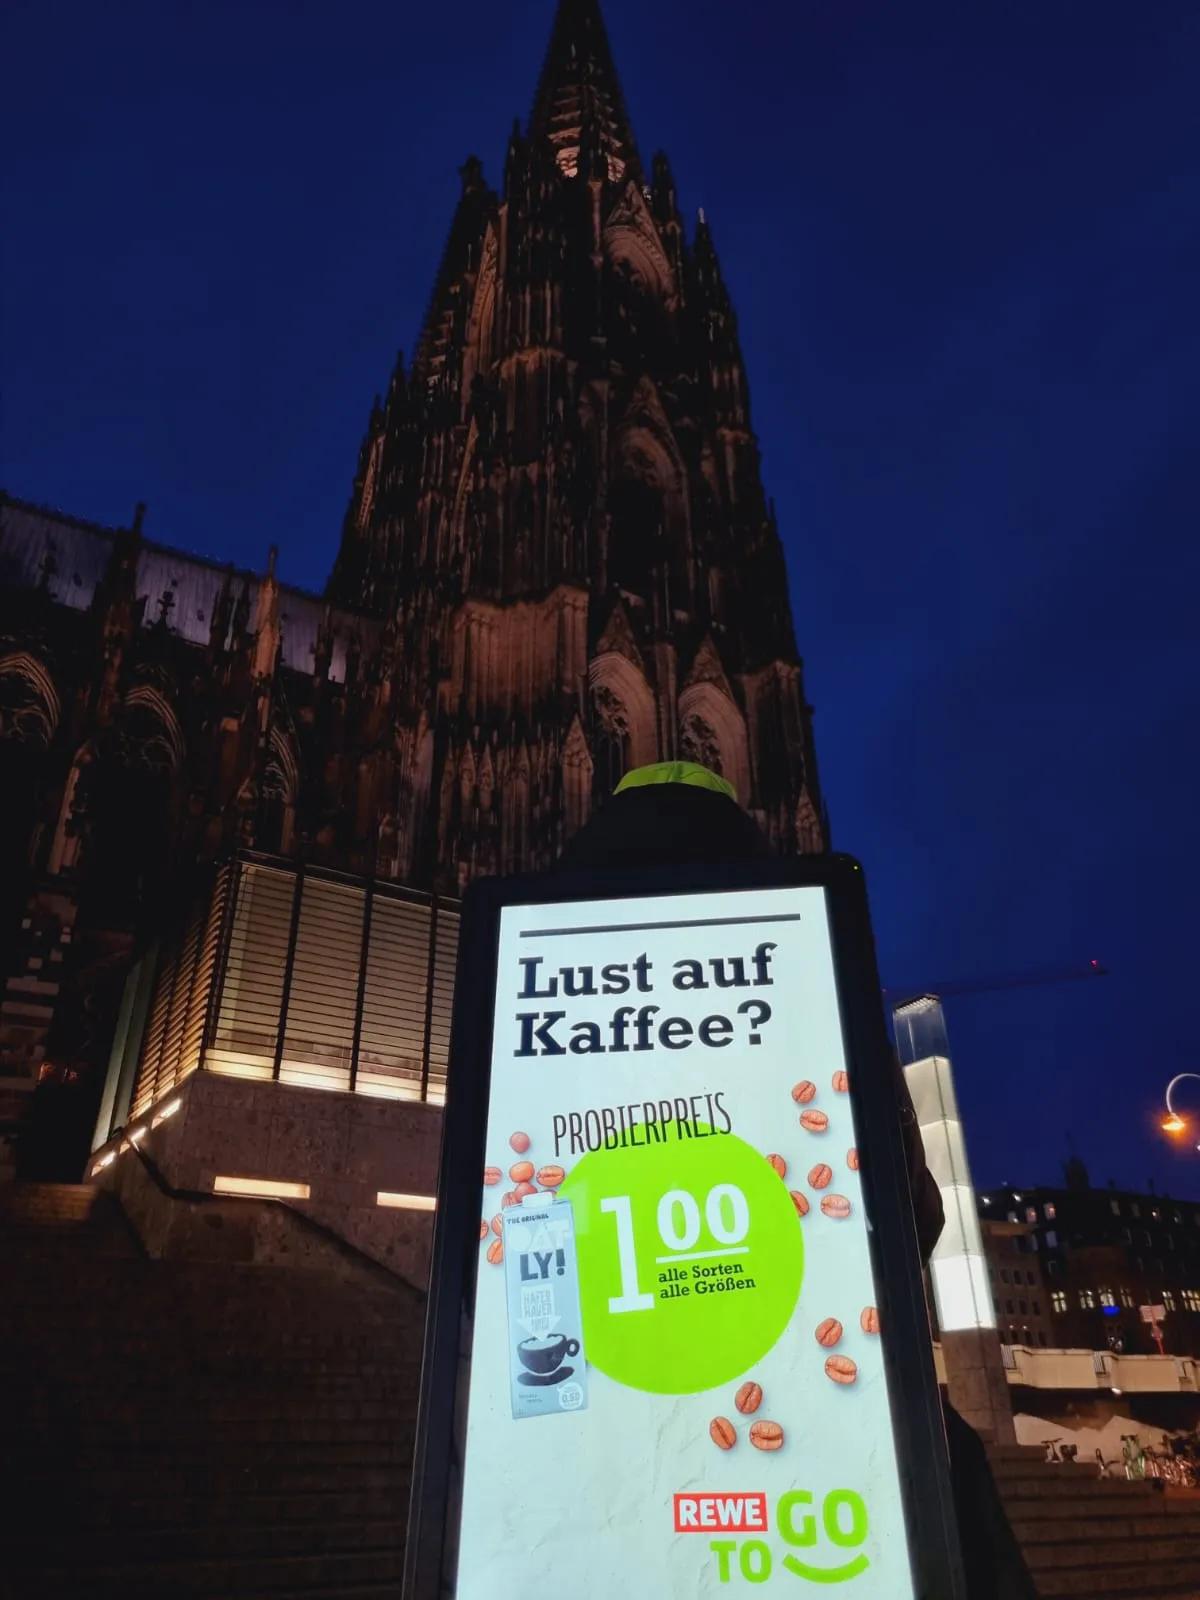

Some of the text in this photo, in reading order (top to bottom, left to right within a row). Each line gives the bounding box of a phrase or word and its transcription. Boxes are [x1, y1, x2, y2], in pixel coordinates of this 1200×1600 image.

[517, 942, 778, 999] Lust auf
[513, 999, 772, 1057] Kaffee?
[552, 1092, 732, 1157] PROBIERPREIS
[519, 1248, 566, 1281] LY!
[658, 1263, 744, 1283] alle Sorten
[660, 1276, 756, 1299] alle Größen
[679, 1498, 763, 1526] REWE
[710, 1488, 869, 1584] TO GO
